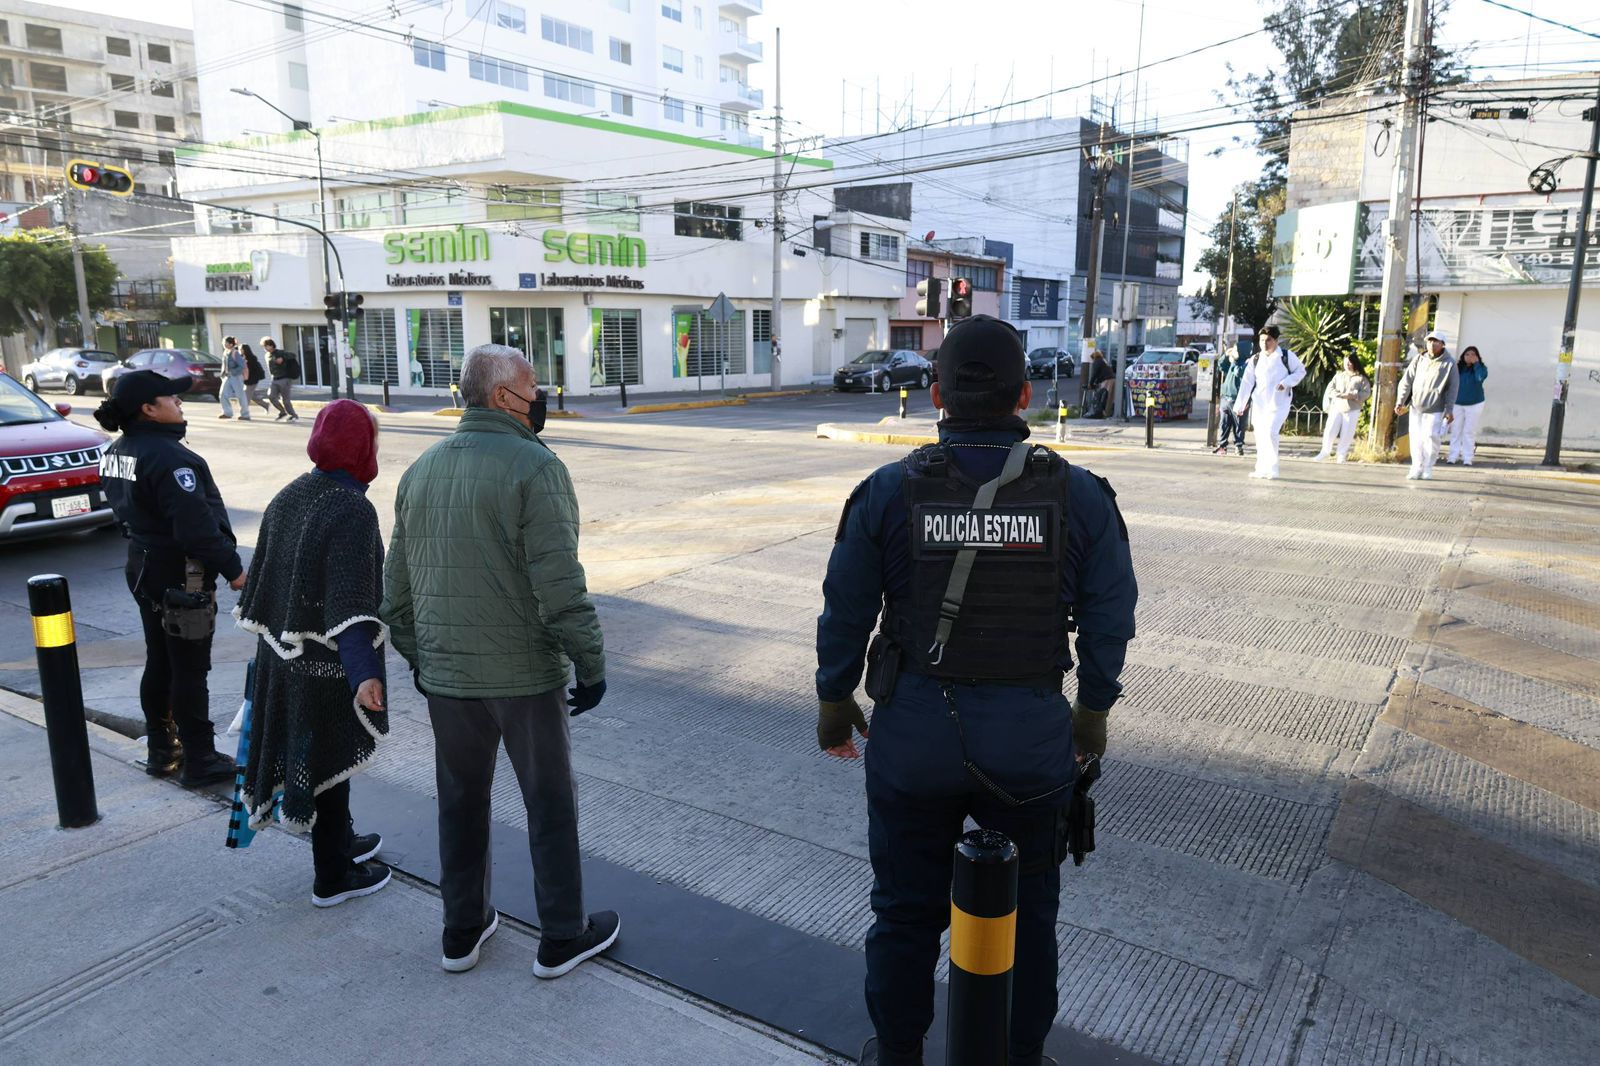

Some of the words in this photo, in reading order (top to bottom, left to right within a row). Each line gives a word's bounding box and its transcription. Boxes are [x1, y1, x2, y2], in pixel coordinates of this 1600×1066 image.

[205, 275, 259, 292] DENTAL
[386, 272, 446, 287] Laboratorios
[540, 271, 605, 287] Laboratorios
[605, 274, 645, 290] Médicos
[924, 511, 980, 542] POLICÍA
[984, 514, 1043, 544] ESTATAL
